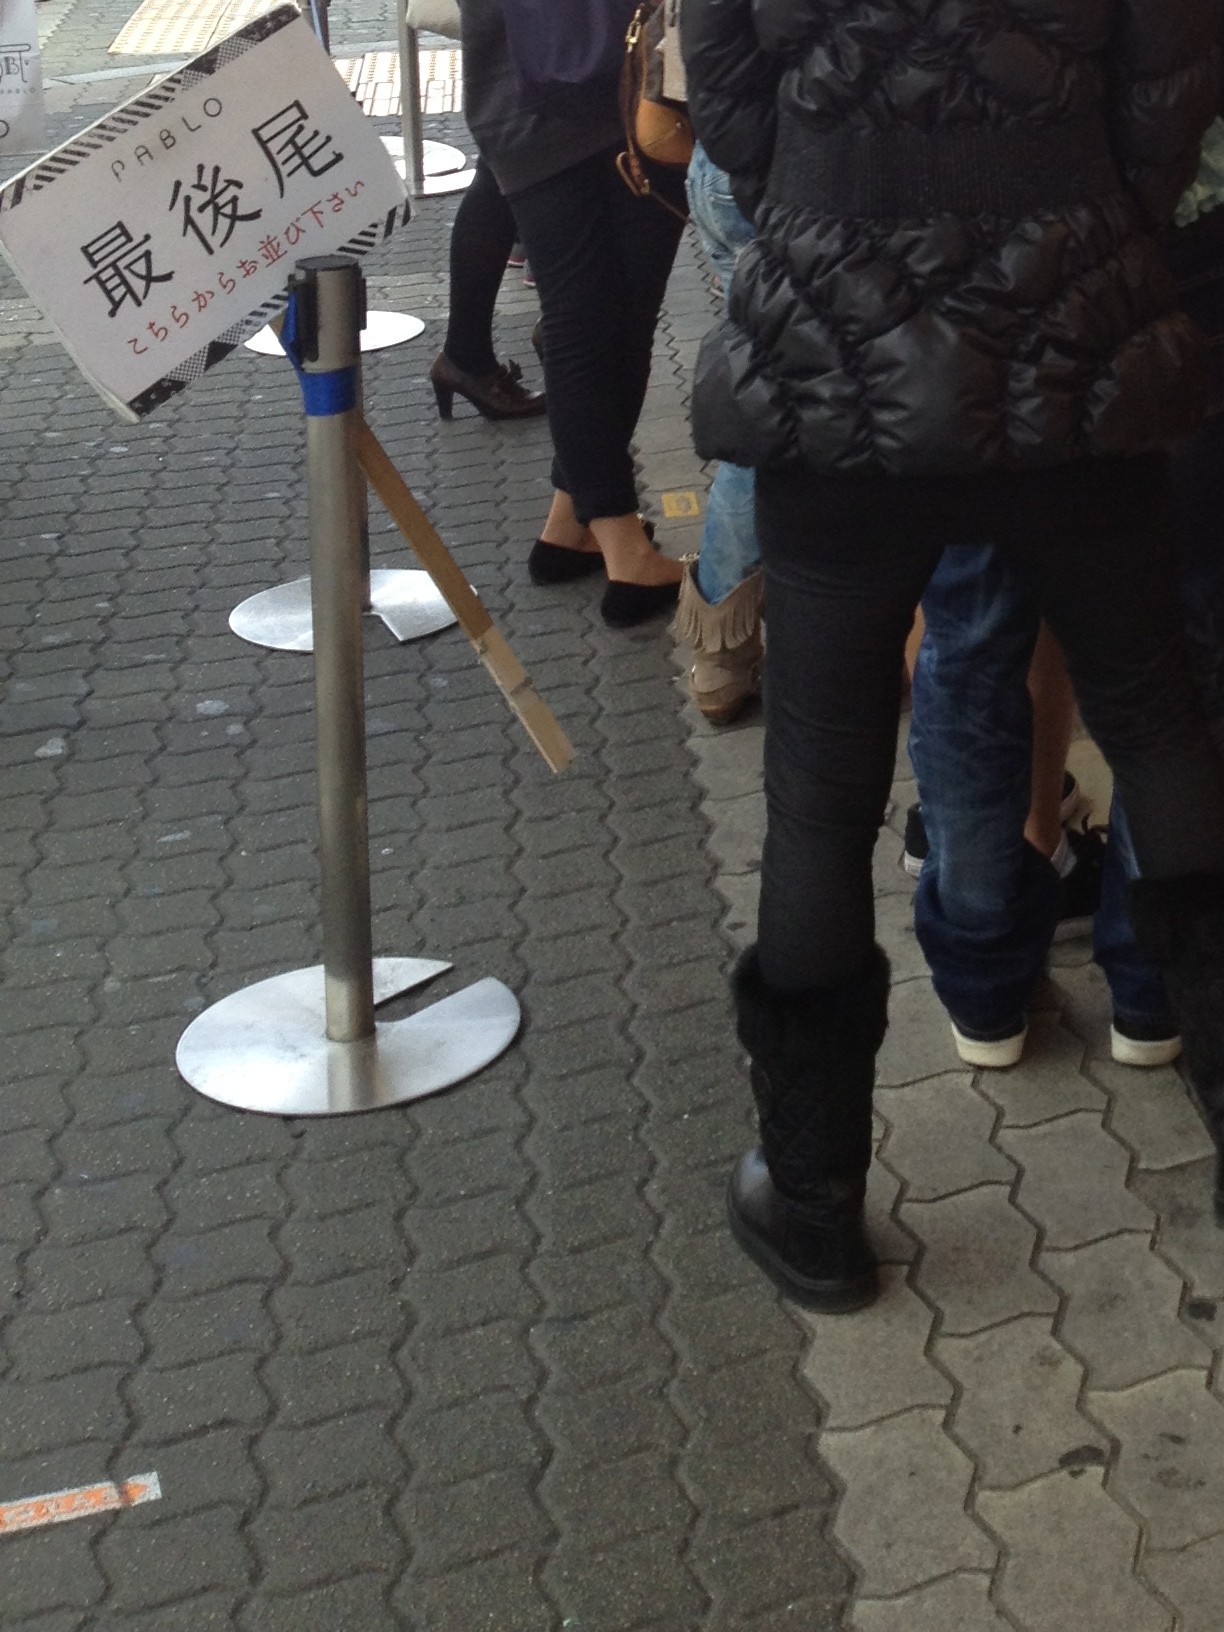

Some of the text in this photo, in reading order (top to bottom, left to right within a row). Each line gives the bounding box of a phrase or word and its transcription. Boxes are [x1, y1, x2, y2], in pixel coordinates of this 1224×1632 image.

[81, 99, 345, 318] 最後尾
[111, 97, 223, 182] PABLO
[128, 179, 365, 356] こちらからお並び下さい
